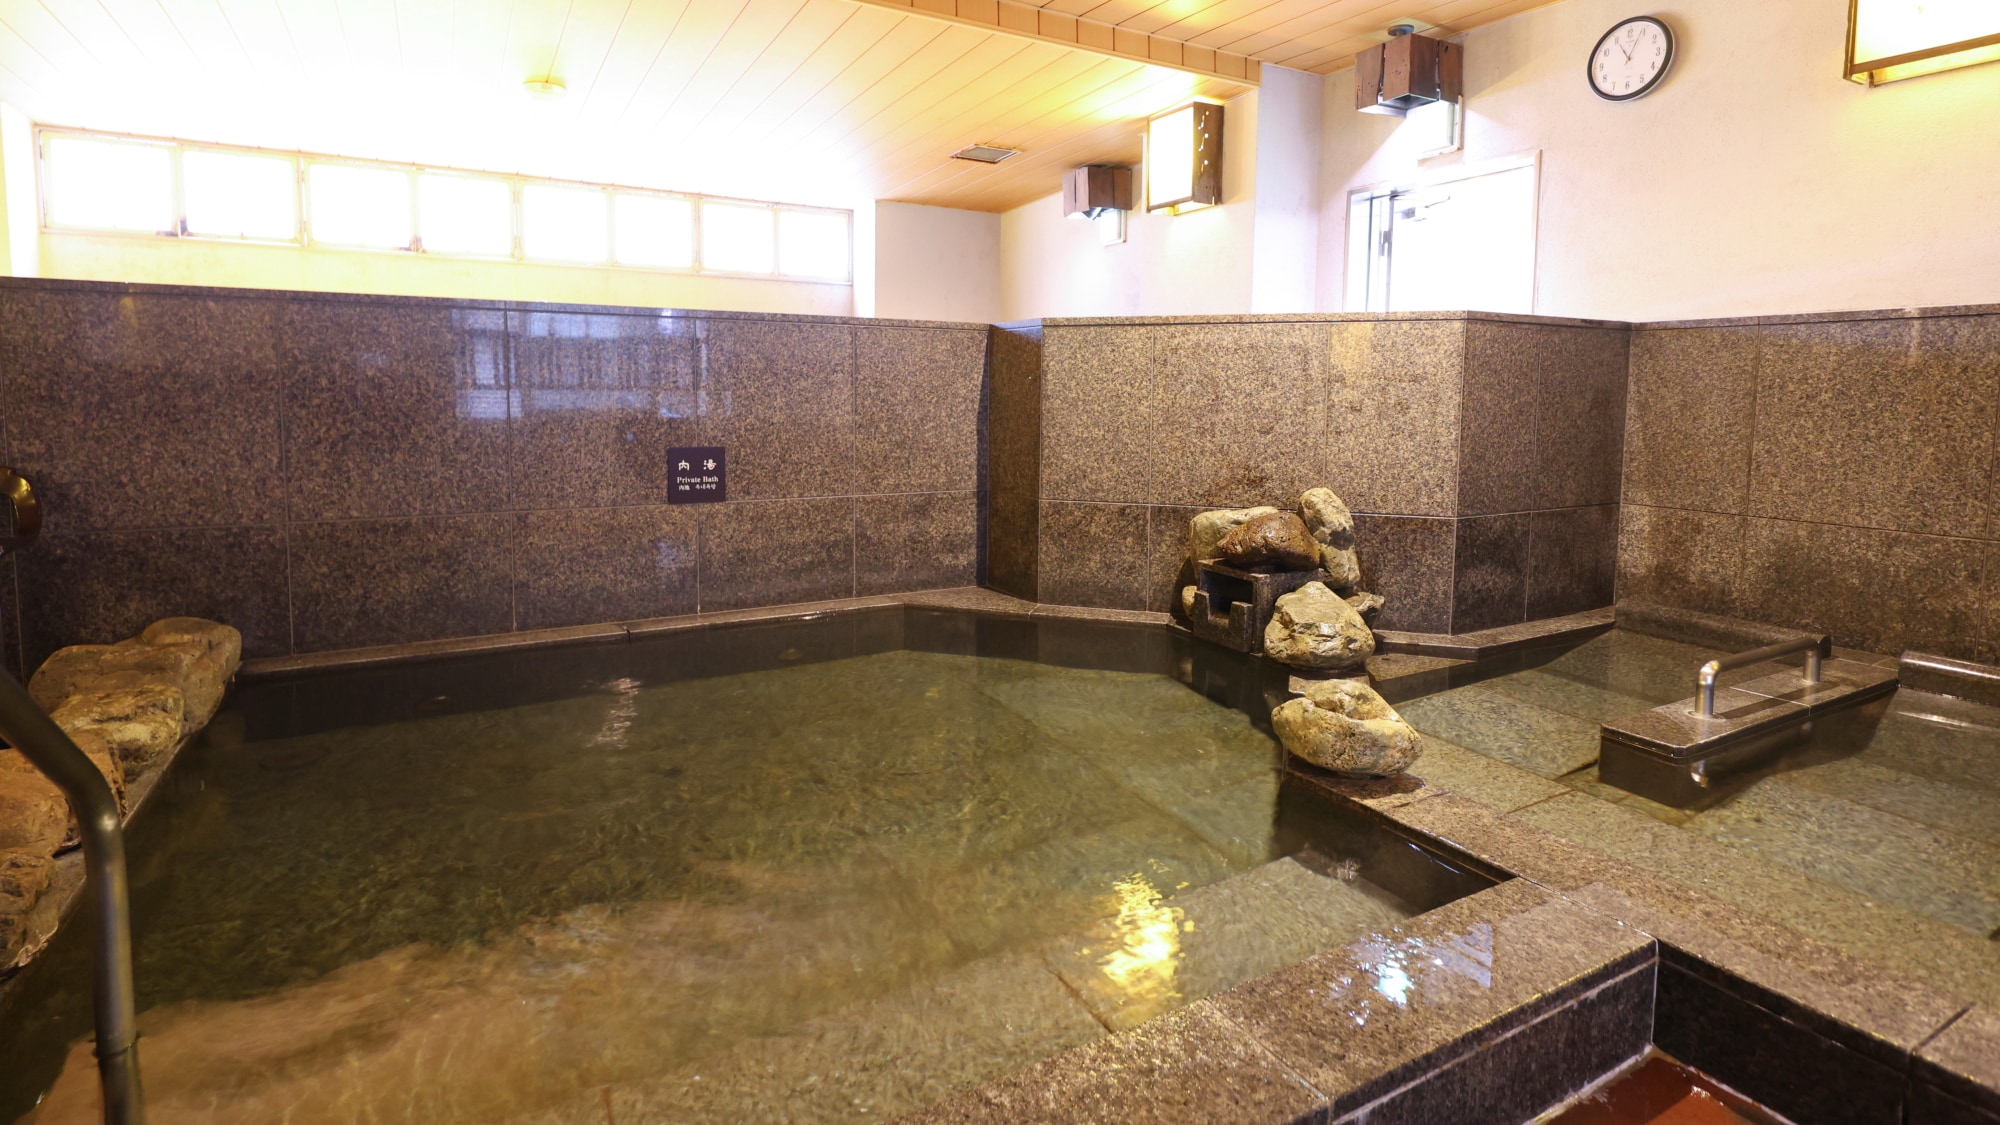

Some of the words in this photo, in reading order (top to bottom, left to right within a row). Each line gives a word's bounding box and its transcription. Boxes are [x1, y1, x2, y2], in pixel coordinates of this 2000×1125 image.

[1652, 34, 1657, 44] 2
[1603, 48, 1610, 57] 10
[1656, 46, 1661, 56] 3
[1599, 62, 1604, 72] 9
[1651, 61, 1655, 71] 4
[1602, 74, 1607, 83] 8
[1639, 74, 1645, 84] 5
[1611, 81, 1617, 91] 7
[1625, 81, 1630, 90] 6
[703, 475, 718, 483] Bath
